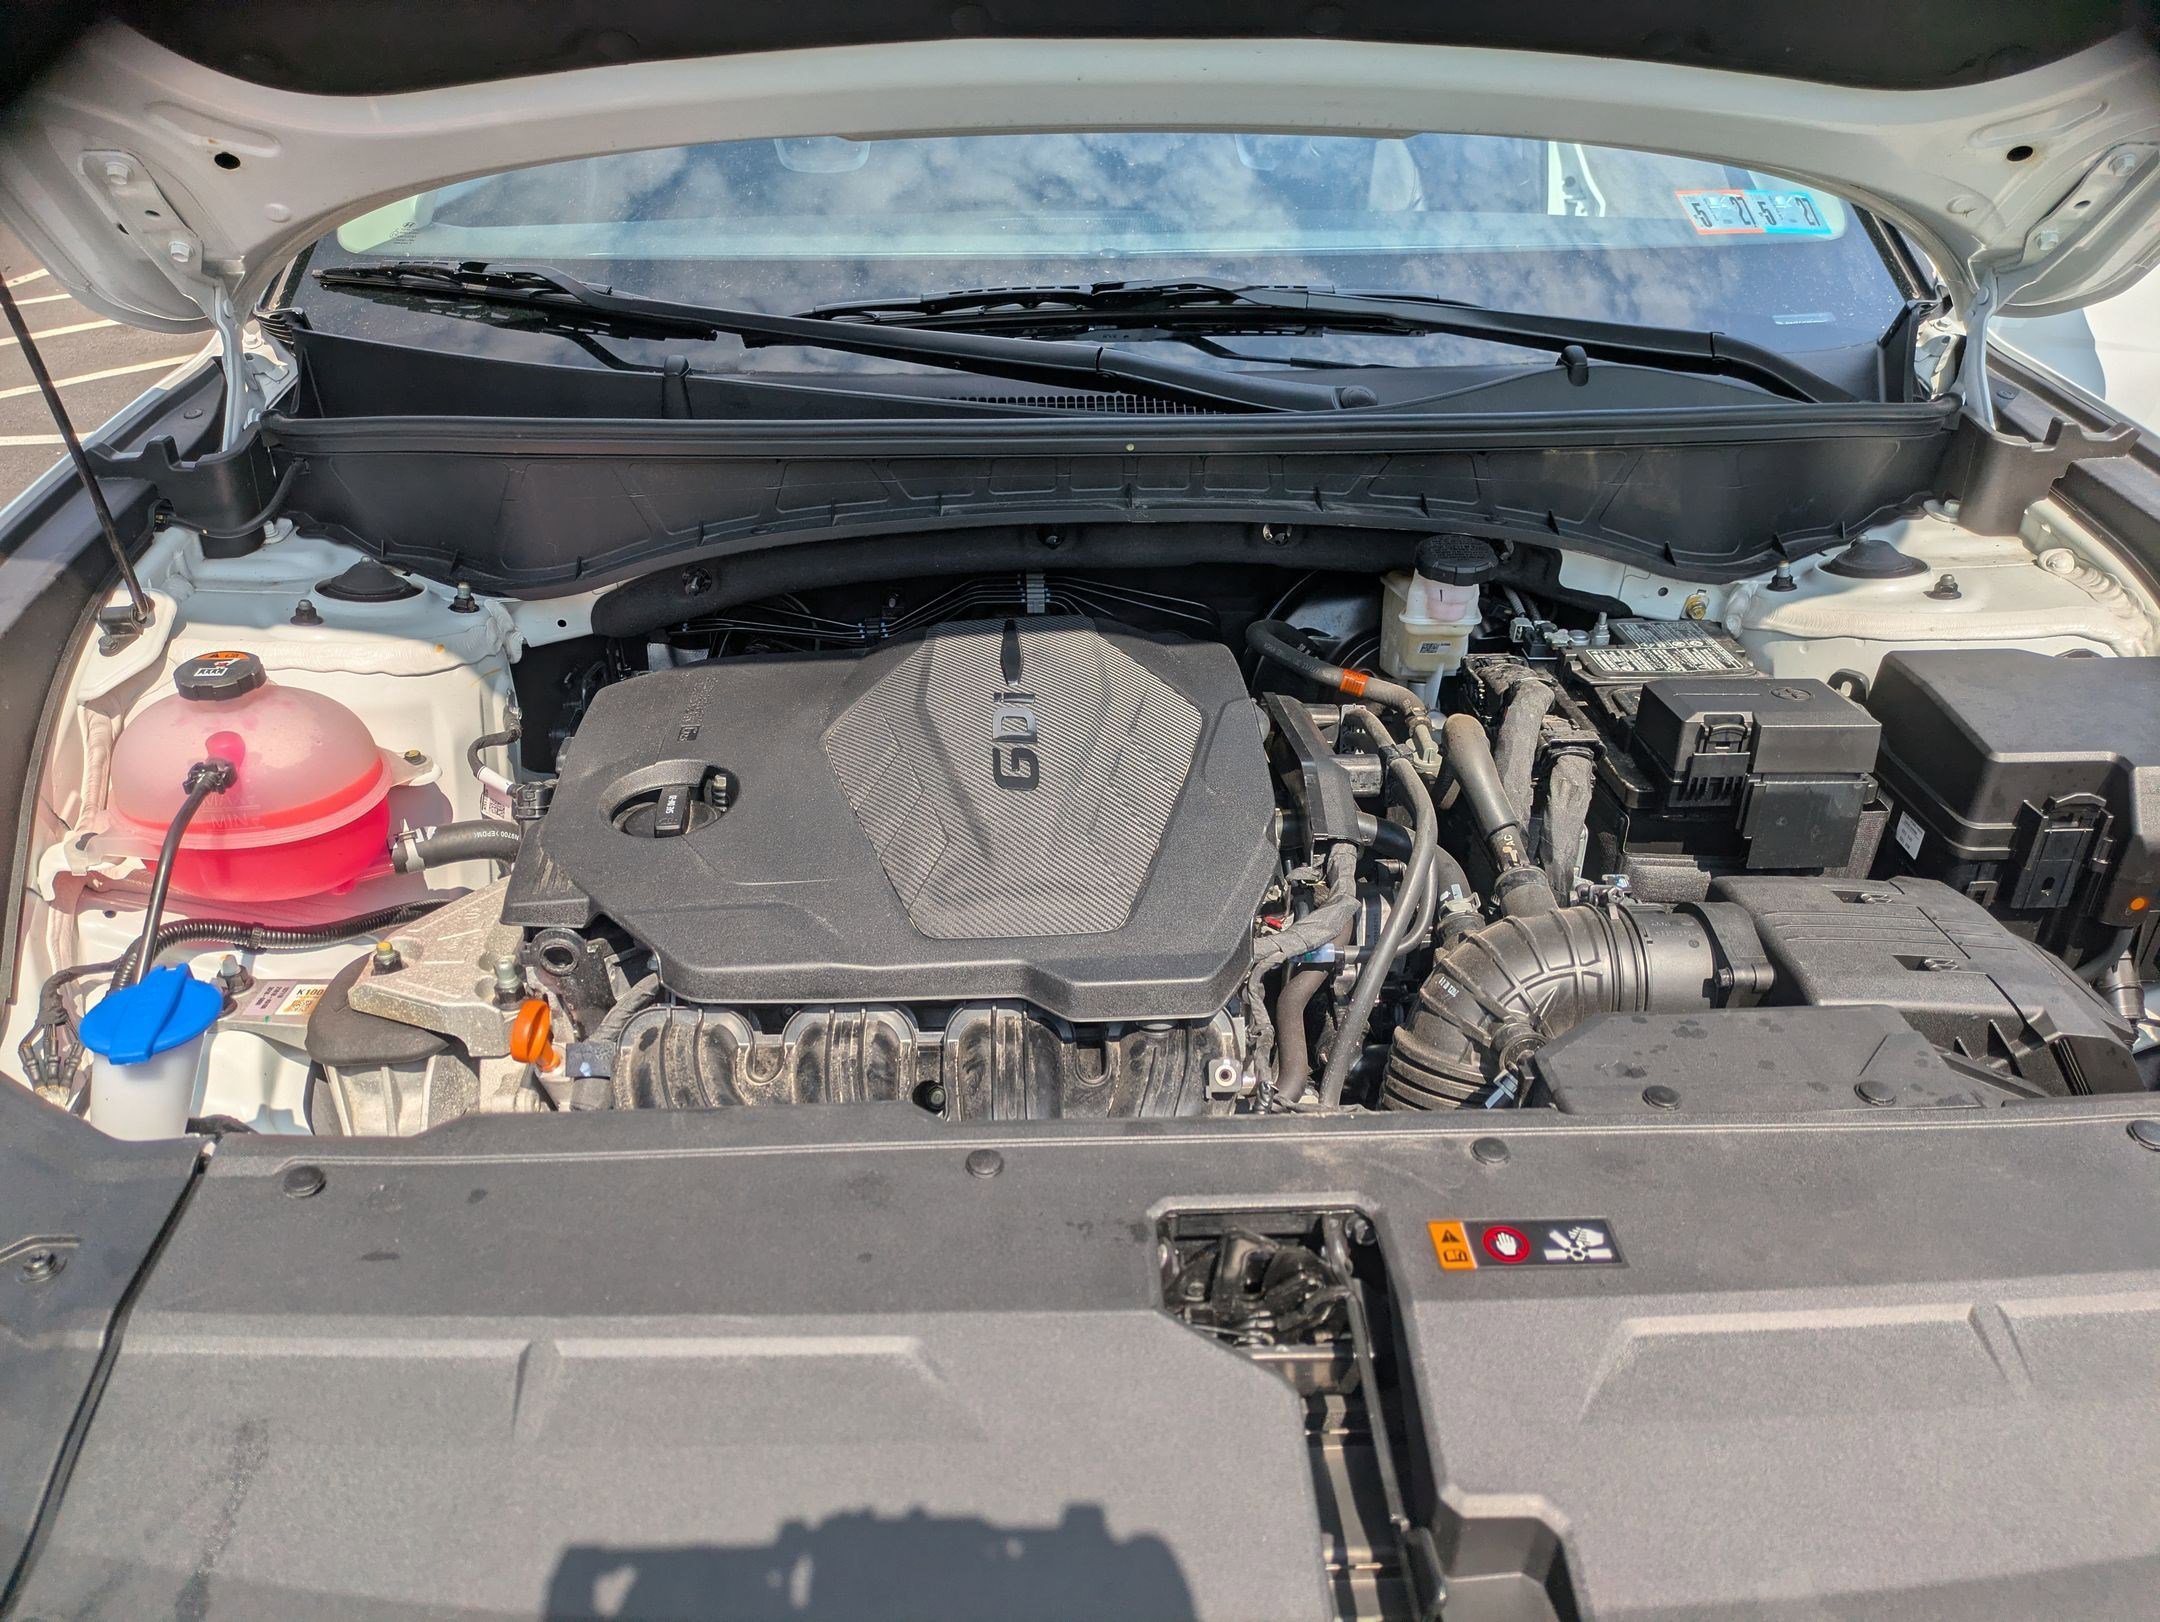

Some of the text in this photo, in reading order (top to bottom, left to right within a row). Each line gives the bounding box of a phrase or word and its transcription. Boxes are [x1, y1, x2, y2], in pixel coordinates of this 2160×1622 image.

[1692, 203, 1712, 228] 5
[1730, 196, 1756, 228] 27
[1758, 201, 1777, 226] 5
[1795, 197, 1820, 227] 27
